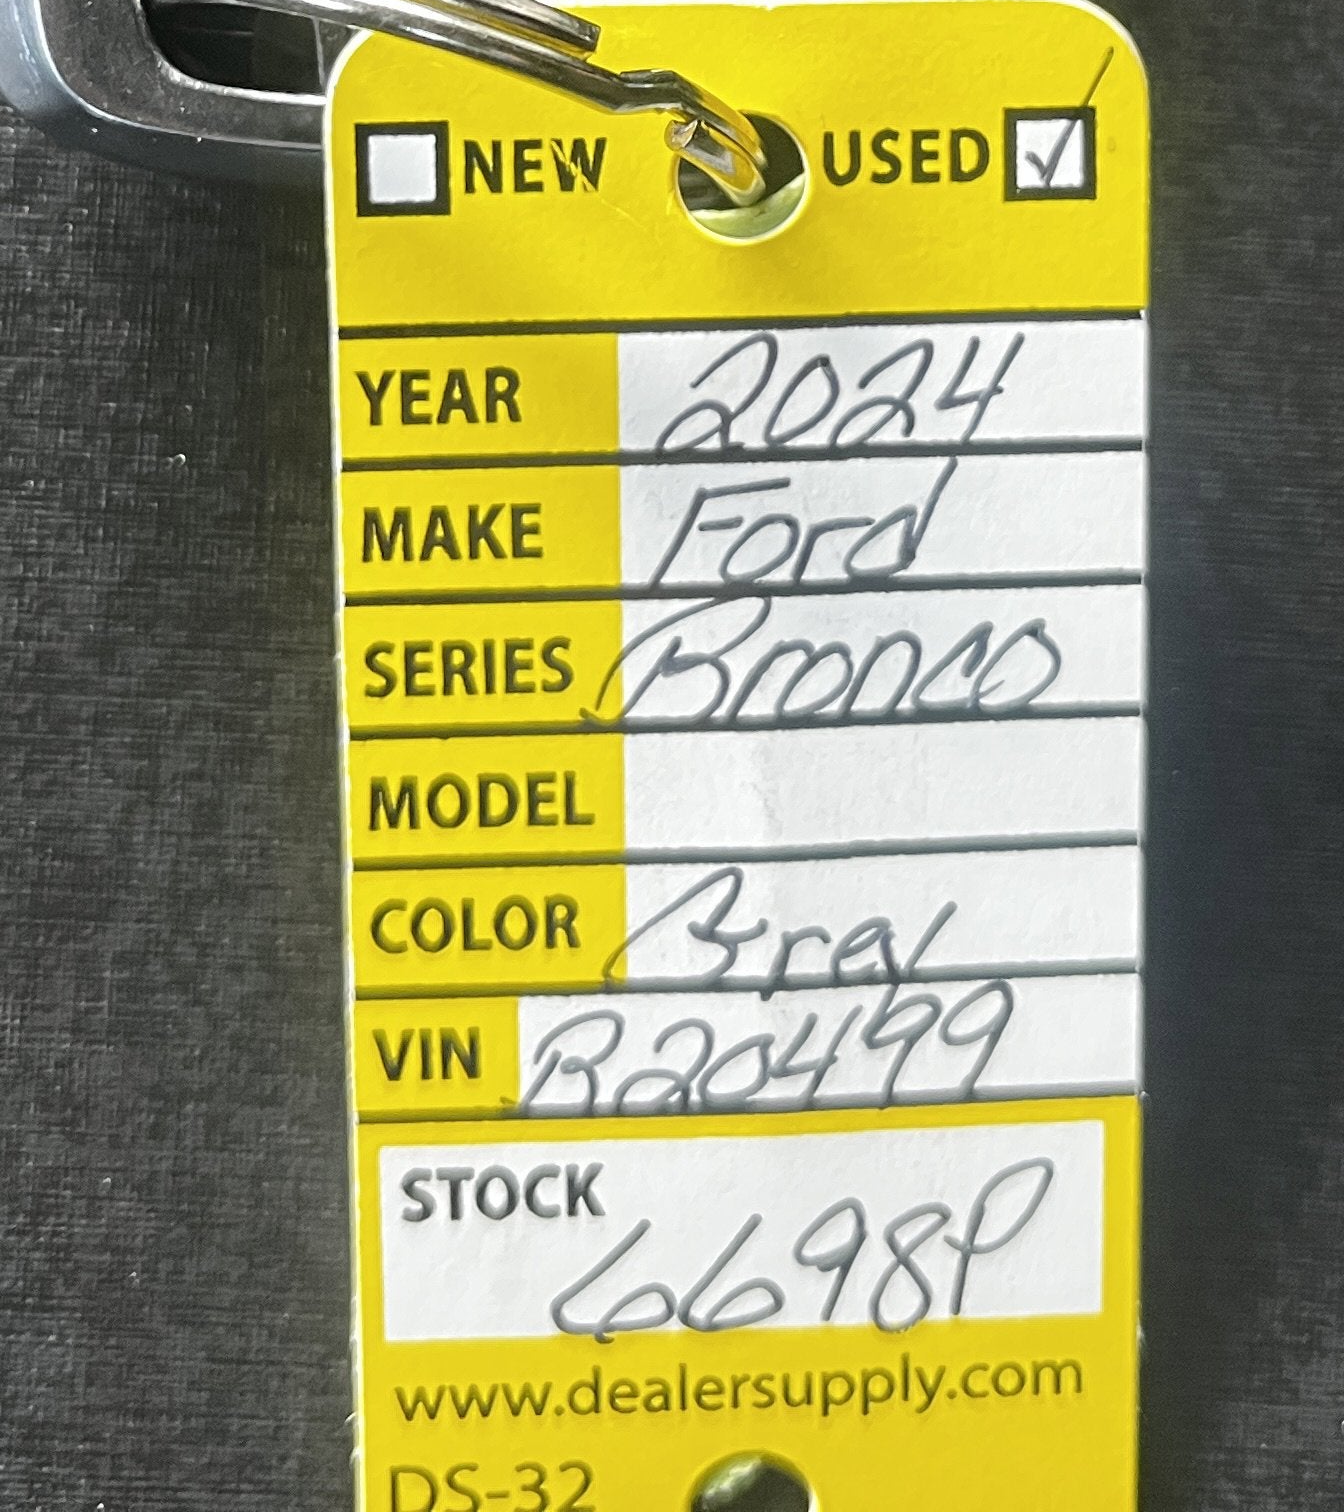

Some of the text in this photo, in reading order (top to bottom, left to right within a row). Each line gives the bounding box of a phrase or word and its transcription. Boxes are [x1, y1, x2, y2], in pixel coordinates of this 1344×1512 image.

[463, 137, 607, 194] NEW
[822, 127, 991, 185] USED
[355, 367, 523, 426] YEAR
[657, 331, 1026, 450] 2024
[360, 502, 545, 563] MAKE
[651, 457, 959, 585] Ford
[363, 636, 576, 700] SERIES
[578, 594, 1060, 724] Bronco
[368, 771, 596, 831] MODEL
[370, 895, 582, 953] COLOR
[373, 1025, 482, 1082] VIN
[399, 1161, 607, 1223] STOCK
[550, 1156, 1056, 1344] 6698P
[393, 1352, 1084, 1426] www.dealersupply.com
[389, 1460, 598, 1512] DS-32
